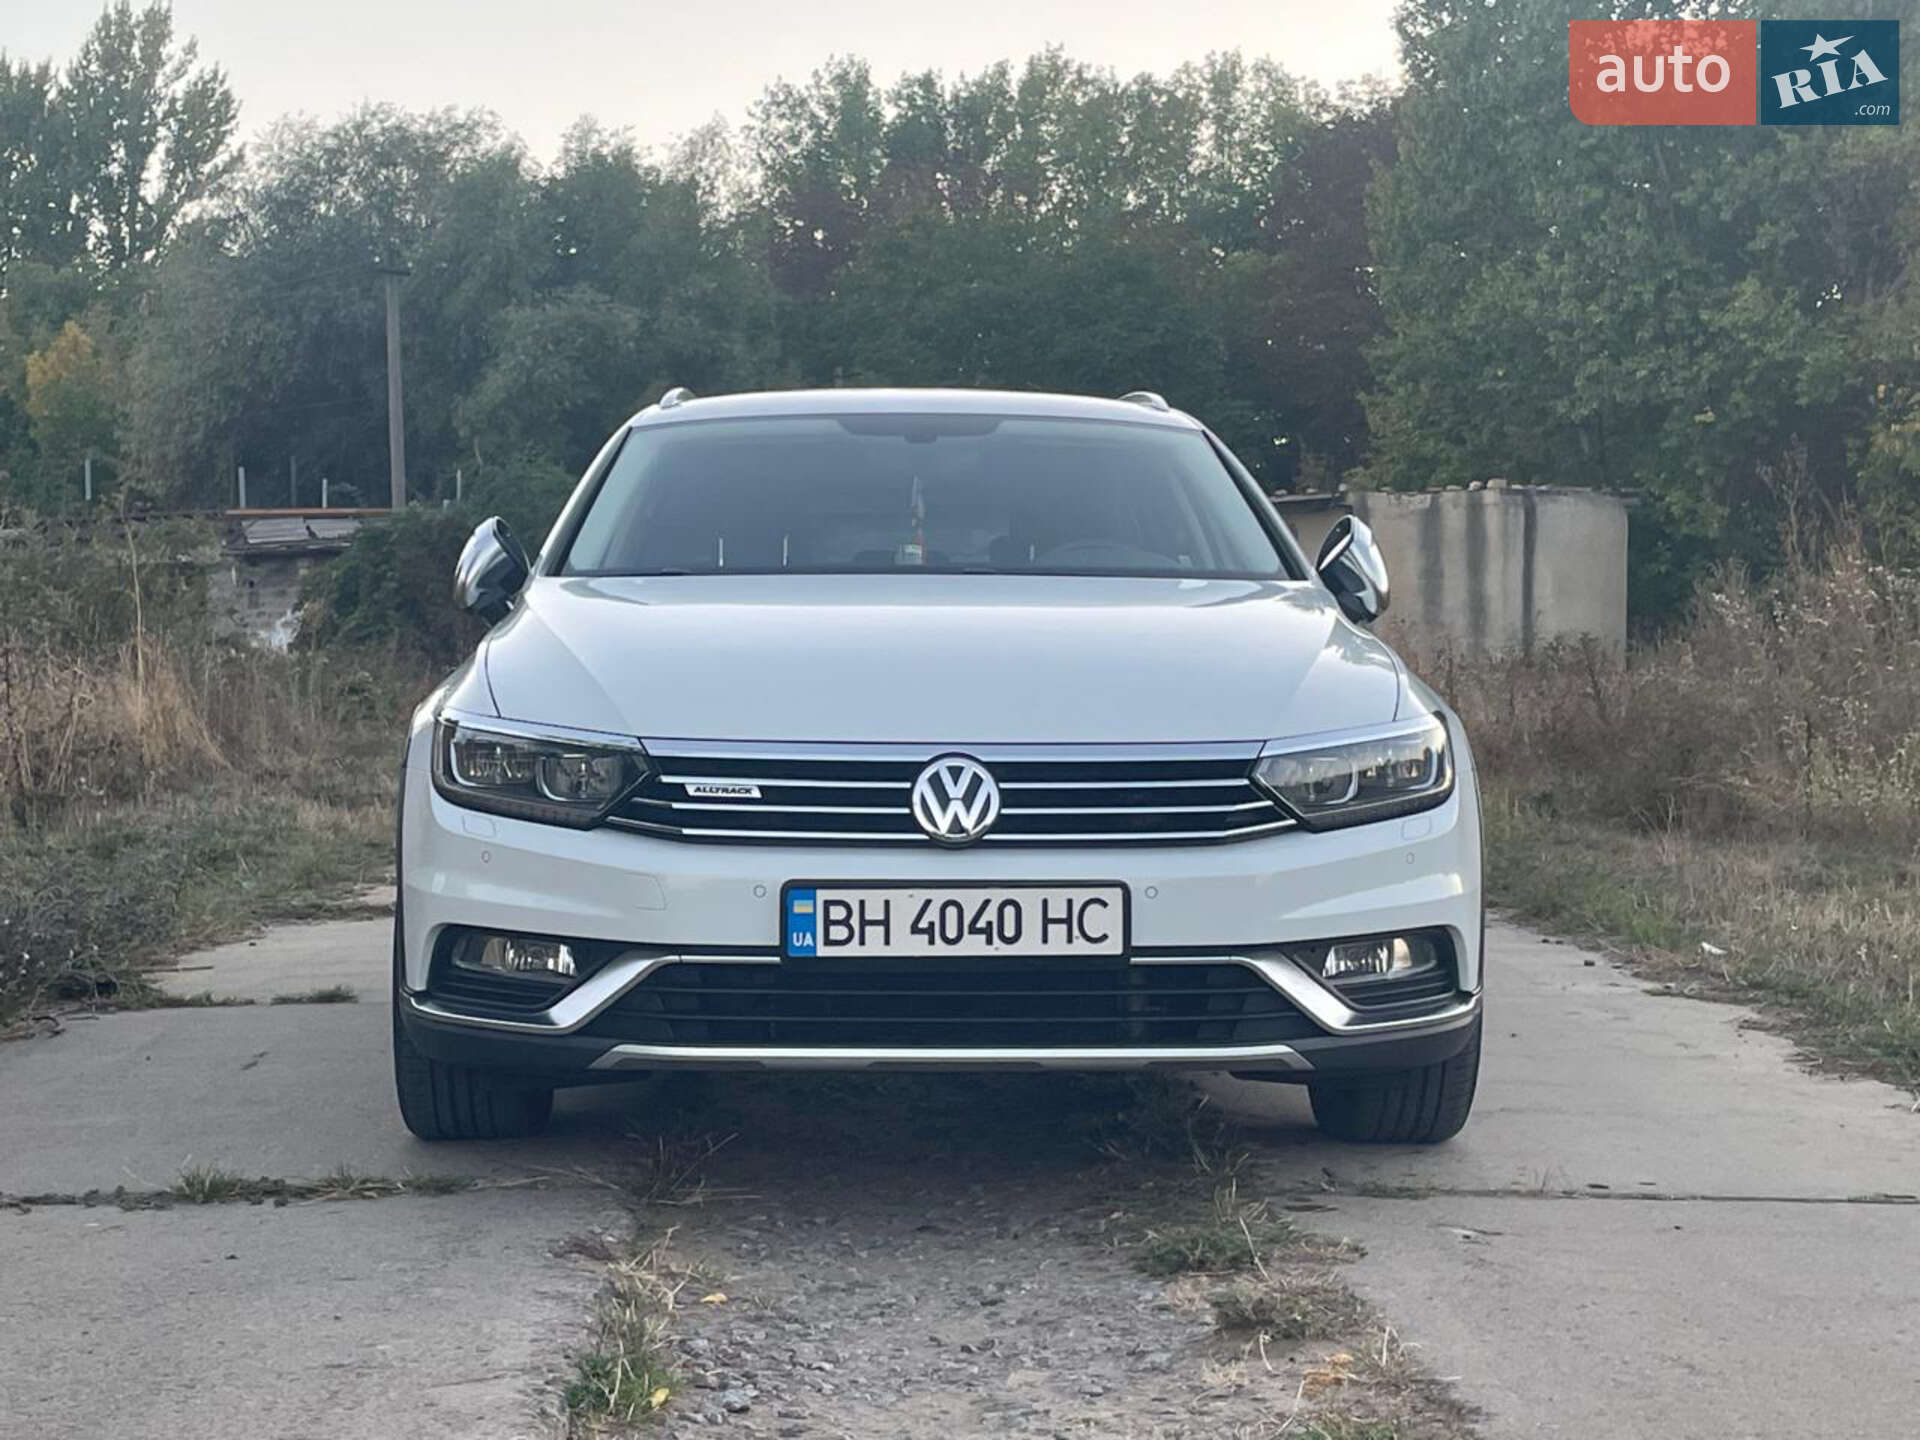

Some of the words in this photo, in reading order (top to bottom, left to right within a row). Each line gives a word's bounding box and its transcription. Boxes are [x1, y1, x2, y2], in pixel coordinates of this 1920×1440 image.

[694, 785, 753, 795] ALLTRACK
[917, 760, 994, 838] VW
[822, 899, 891, 947] BH
[910, 898, 1022, 946] 4040
[1041, 897, 1109, 945] HC
[792, 932, 814, 947] UA
